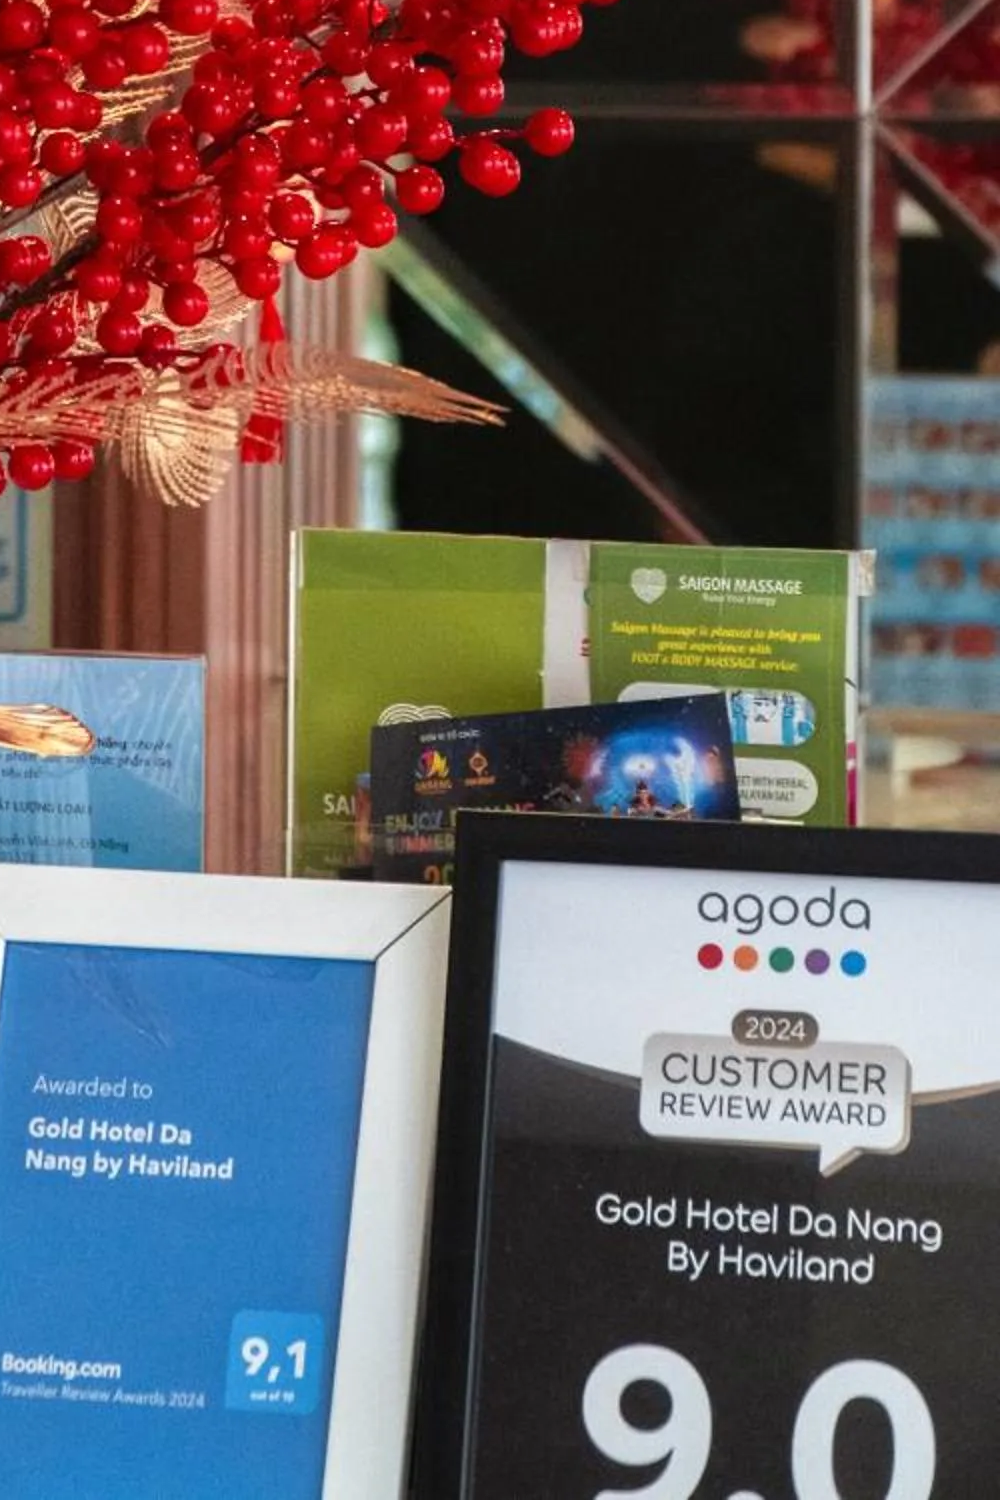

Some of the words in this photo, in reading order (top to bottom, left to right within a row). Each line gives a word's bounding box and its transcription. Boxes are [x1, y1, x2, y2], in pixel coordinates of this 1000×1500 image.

[679, 575, 731, 592] SAIGON
[734, 579, 803, 595] MASSAGE
[611, 621, 649, 635] Saigon
[651, 623, 697, 637] Massage
[710, 626, 752, 640] pleased
[754, 628, 766, 639] to
[768, 628, 797, 643] bring
[799, 631, 822, 643] you
[631, 651, 661, 664] FOOT
[671, 654, 702, 667] BODY
[704, 656, 757, 670] MASSAGE
[689, 642, 745, 654] experience
[748, 643, 773, 655] with
[385, 810, 444, 835] ENJOY
[698, 886, 871, 934] agoda
[744, 1015, 806, 1041] 2024
[32, 1074, 126, 1098] Awarded
[132, 1082, 153, 1100] to
[660, 1051, 887, 1097] CUSTOMER
[659, 1092, 770, 1122] REVIEW
[779, 1099, 887, 1128] AWARD
[28, 1116, 83, 1139] Gold
[90, 1120, 152, 1143] Hotel
[160, 1123, 192, 1145] Da
[25, 1148, 87, 1177] Nang
[93, 1151, 123, 1179] by
[129, 1154, 234, 1180] Haviland
[595, 1193, 676, 1228] Gold
[687, 1198, 779, 1235] Hotel
[789, 1206, 837, 1239] Da
[846, 1210, 943, 1253] Nang
[667, 1241, 710, 1282] By
[718, 1245, 875, 1285] Haviland
[1, 1353, 121, 1379] Booking.com
[241, 1336, 308, 1383] 9,1
[0, 1380, 58, 1398] Traveller
[61, 1383, 111, 1402] Review
[113, 1389, 165, 1407] Awards
[167, 1391, 206, 1409] 2024
[250, 1391, 267, 1401] out
[269, 1390, 281, 1401] of
[582, 1342, 937, 1500] 90
